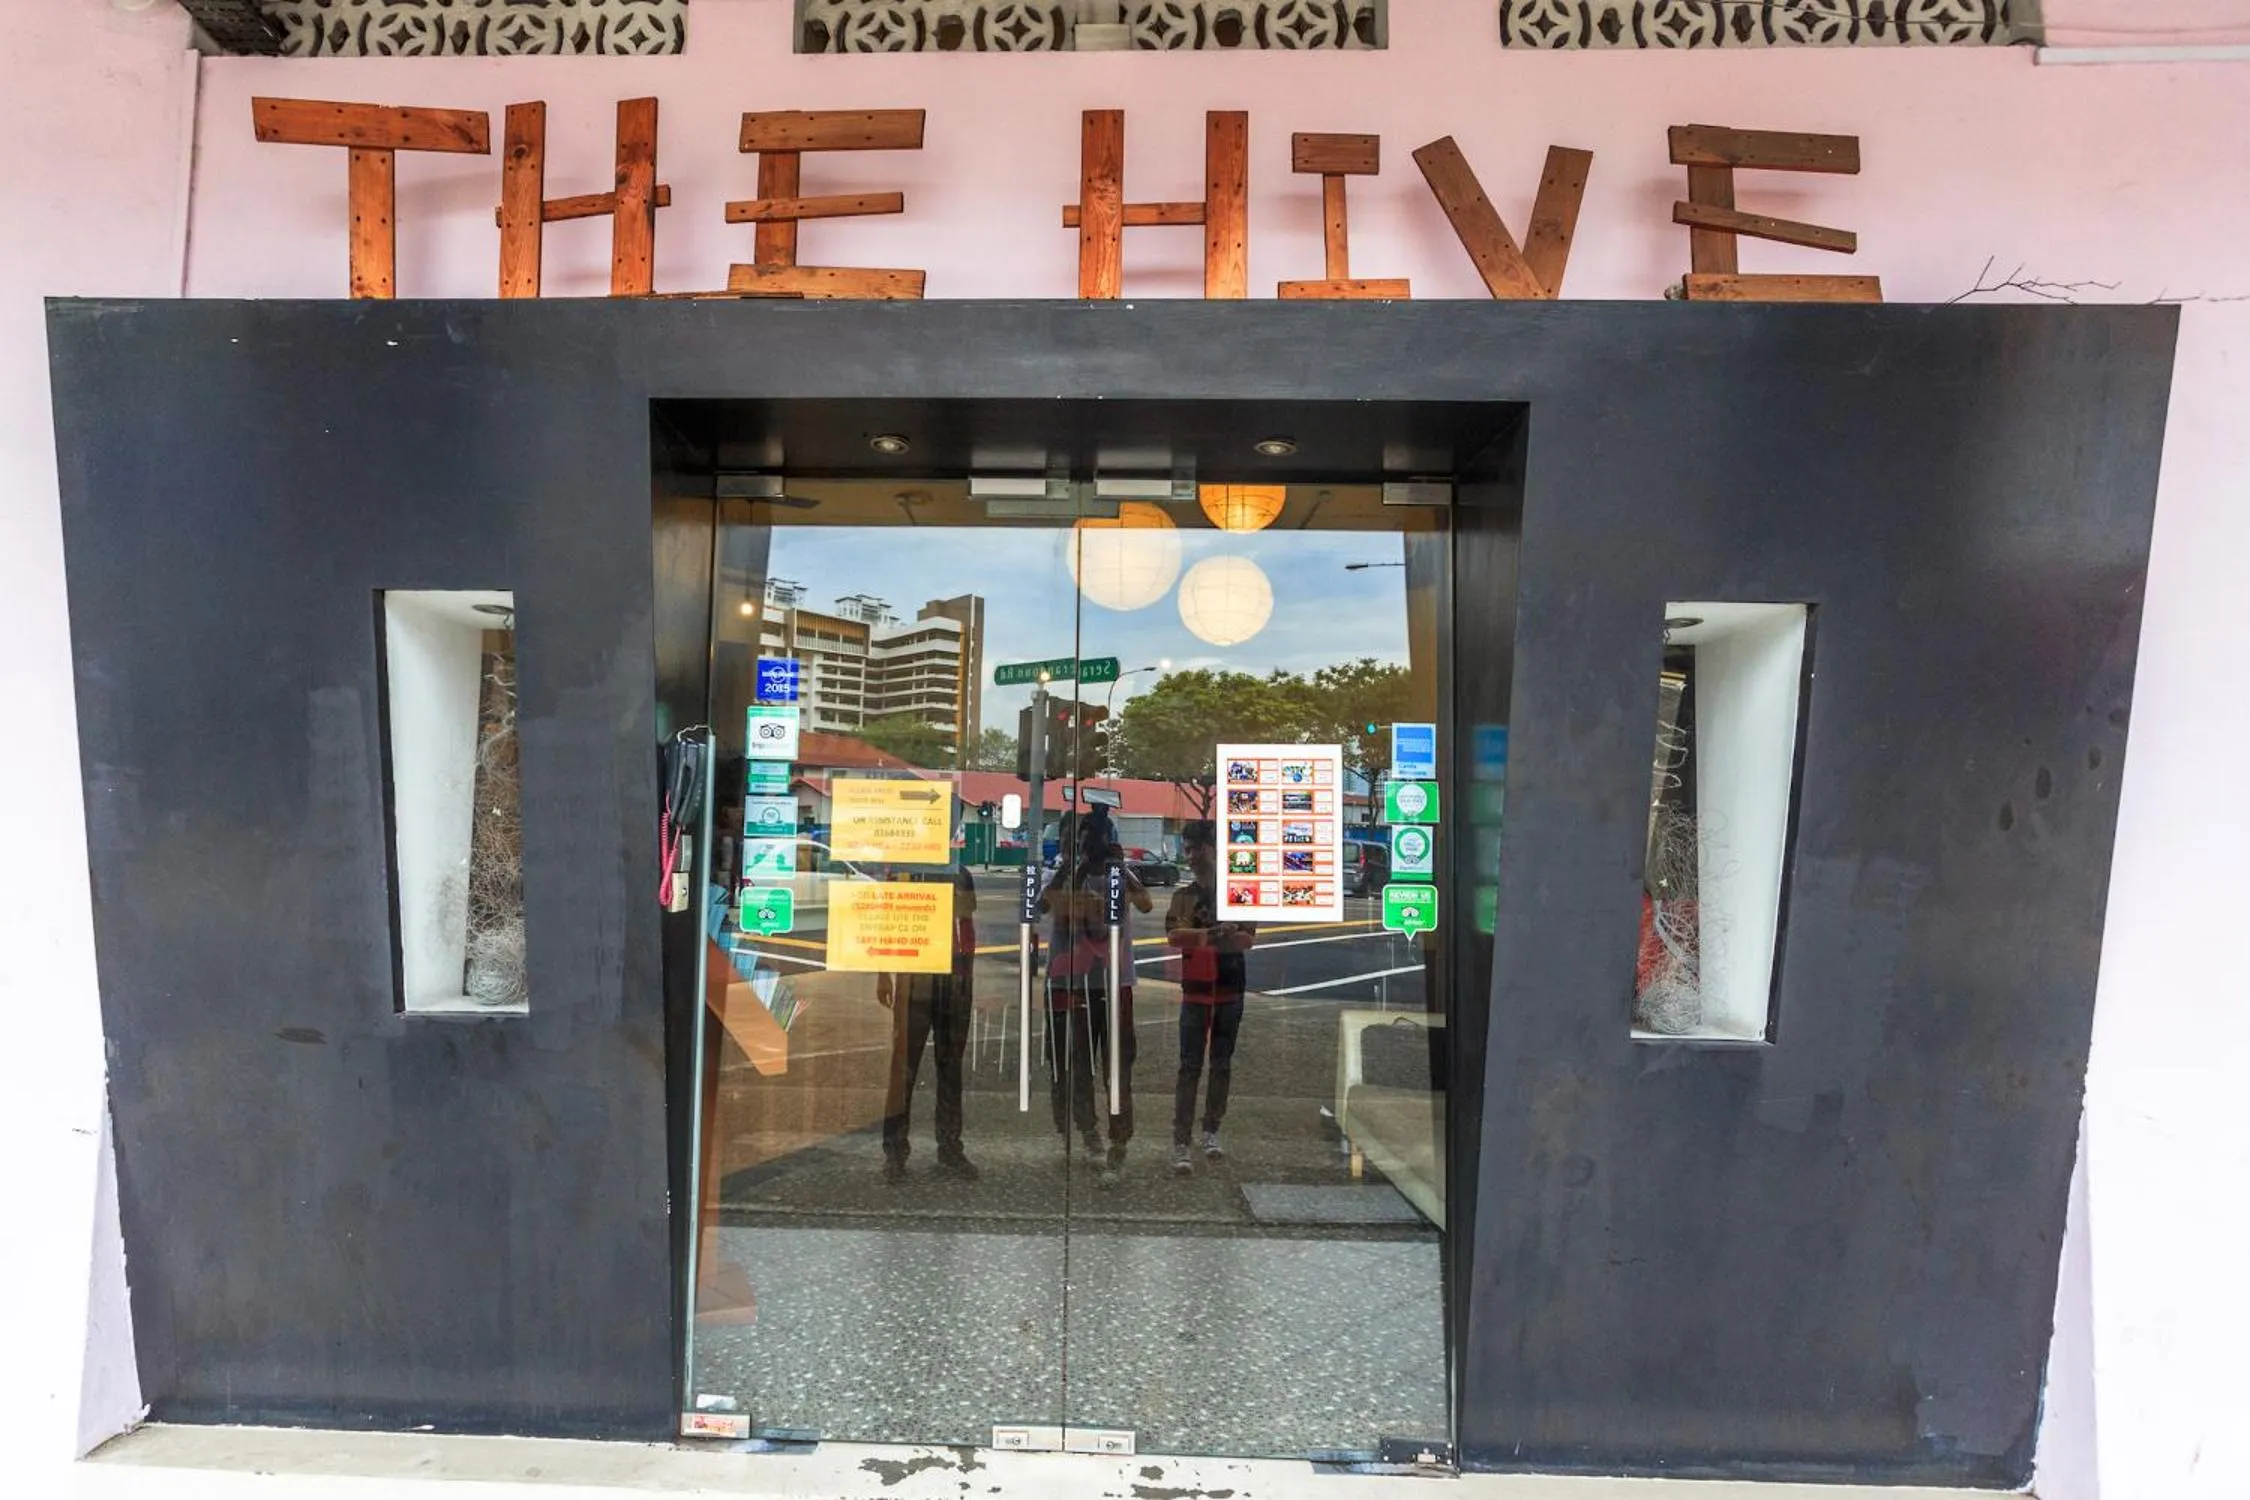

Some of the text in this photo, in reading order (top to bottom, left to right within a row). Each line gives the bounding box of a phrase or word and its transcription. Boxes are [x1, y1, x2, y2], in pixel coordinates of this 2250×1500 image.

[251, 96, 1883, 304] THE HIVE
[764, 683, 791, 694] 2015
[896, 892, 938, 901] ARRIVAL
[1026, 877, 1034, 919] PULL
[1110, 878, 1119, 921] PULL
[879, 936, 909, 946] HAND
[910, 937, 931, 946] SIDE
